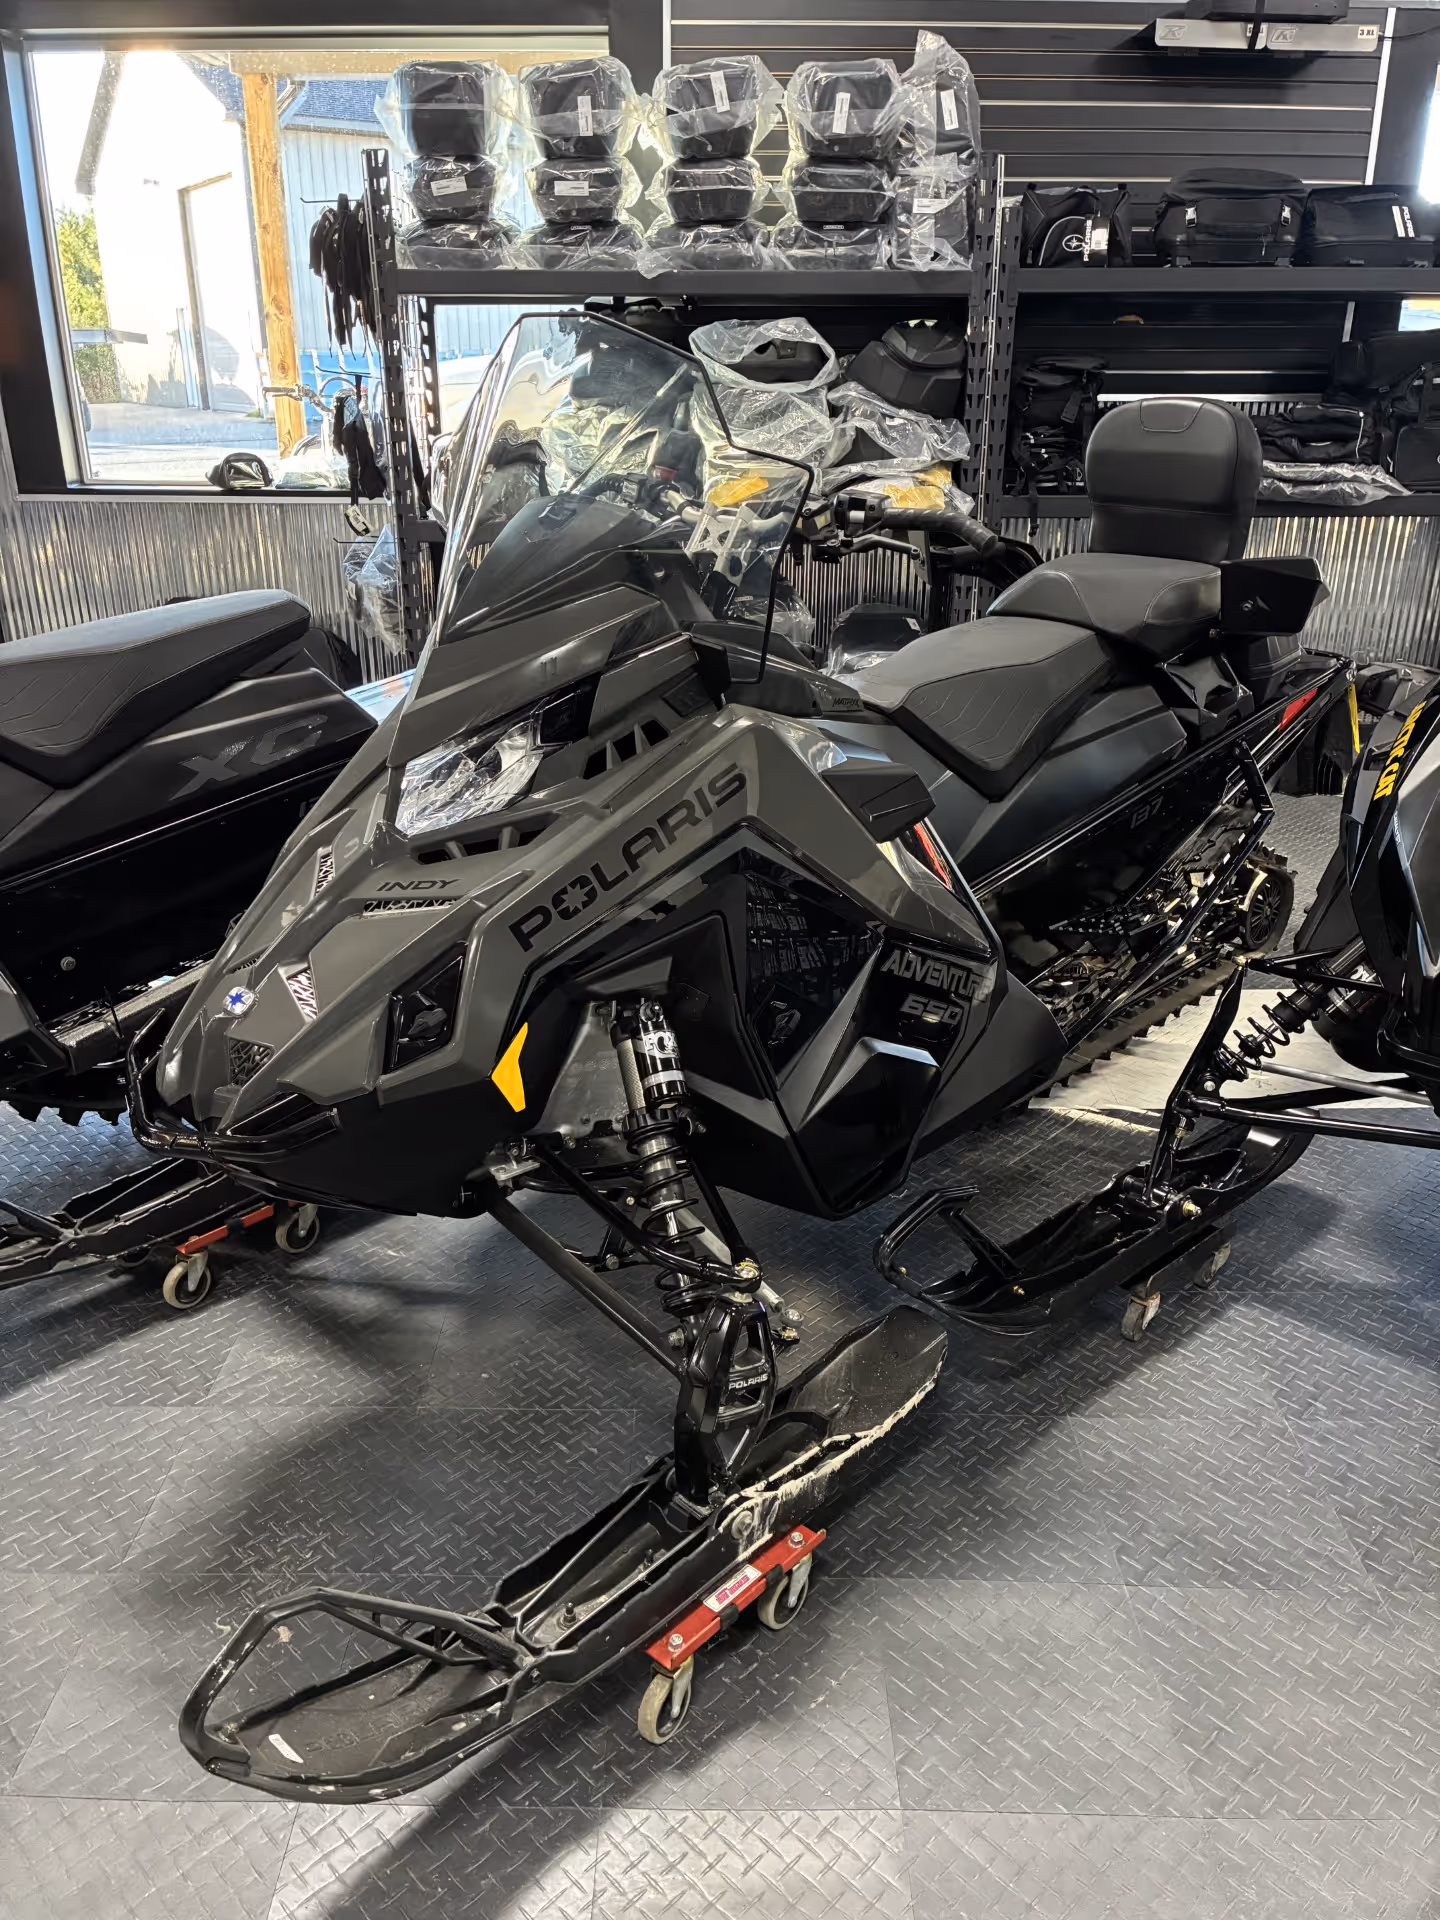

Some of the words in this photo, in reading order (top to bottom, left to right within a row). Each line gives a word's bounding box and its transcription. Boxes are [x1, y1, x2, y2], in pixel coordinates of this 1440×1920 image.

[1401, 205, 1416, 238] POLARIS
[1083, 220, 1093, 262] POLARIS
[1385, 700, 1428, 767] ARCTIC
[169, 714, 329, 801] XC
[1373, 762, 1400, 801] CAT
[1130, 795, 1164, 829] 137
[508, 762, 747, 953] POLARIS
[376, 879, 461, 892] INDY
[900, 993, 962, 1025] 650
[728, 1373, 769, 1391] POLARIS
